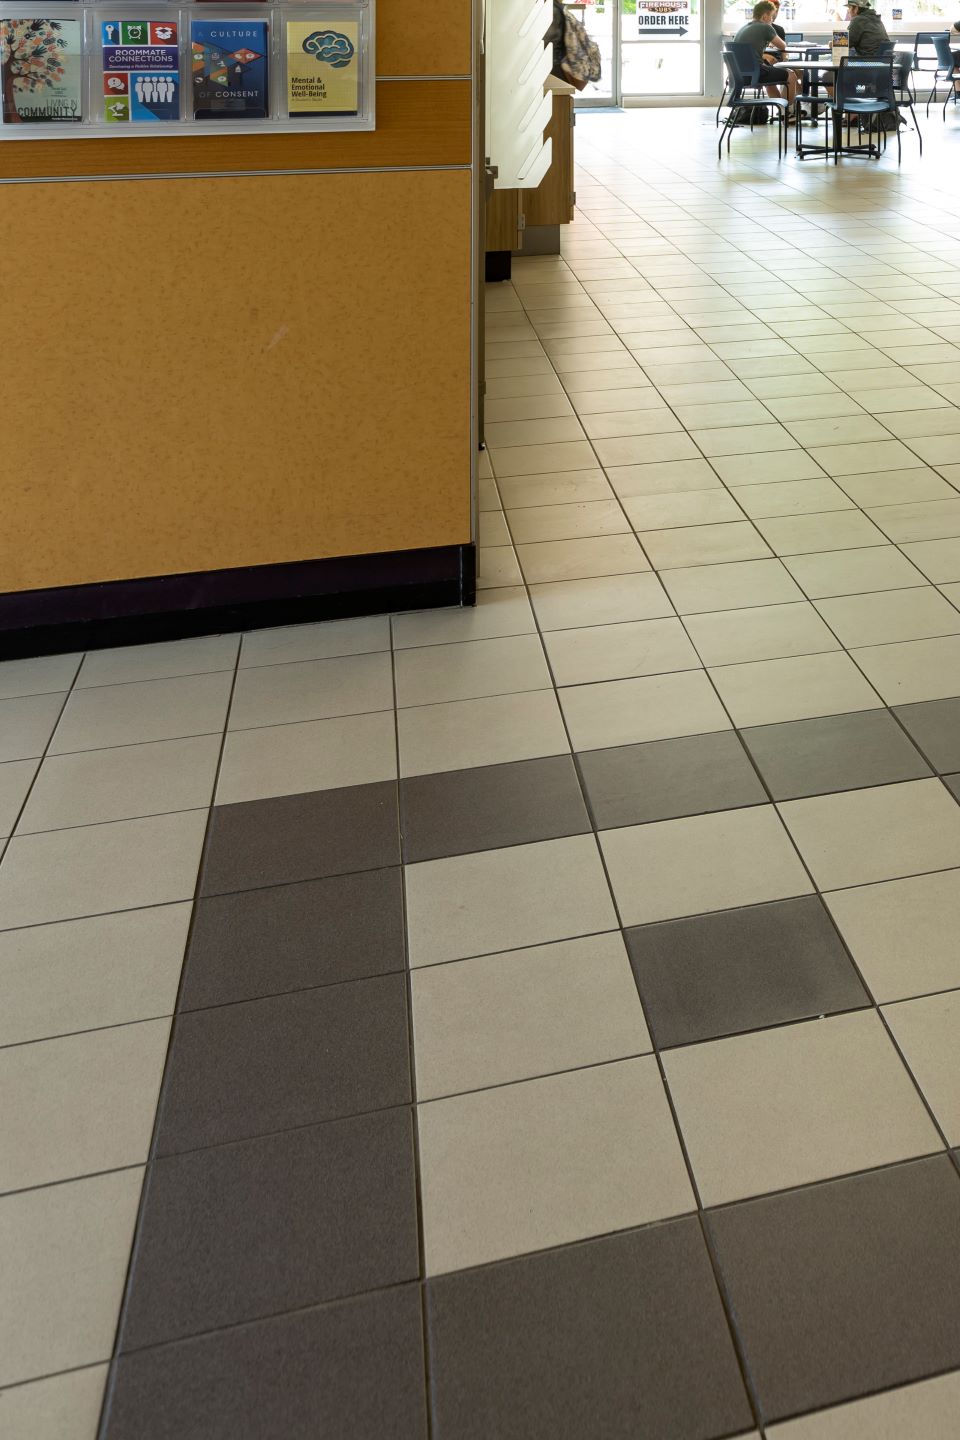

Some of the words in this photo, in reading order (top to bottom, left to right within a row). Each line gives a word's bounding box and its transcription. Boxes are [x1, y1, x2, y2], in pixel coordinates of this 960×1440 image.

[640, 1, 687, 9] FIREHOUSE
[639, 15, 666, 25] ORDER
[668, 15, 689, 25] HERE
[210, 30, 257, 38] CULTURE
[17, 105, 77, 117] COMMUNITY
